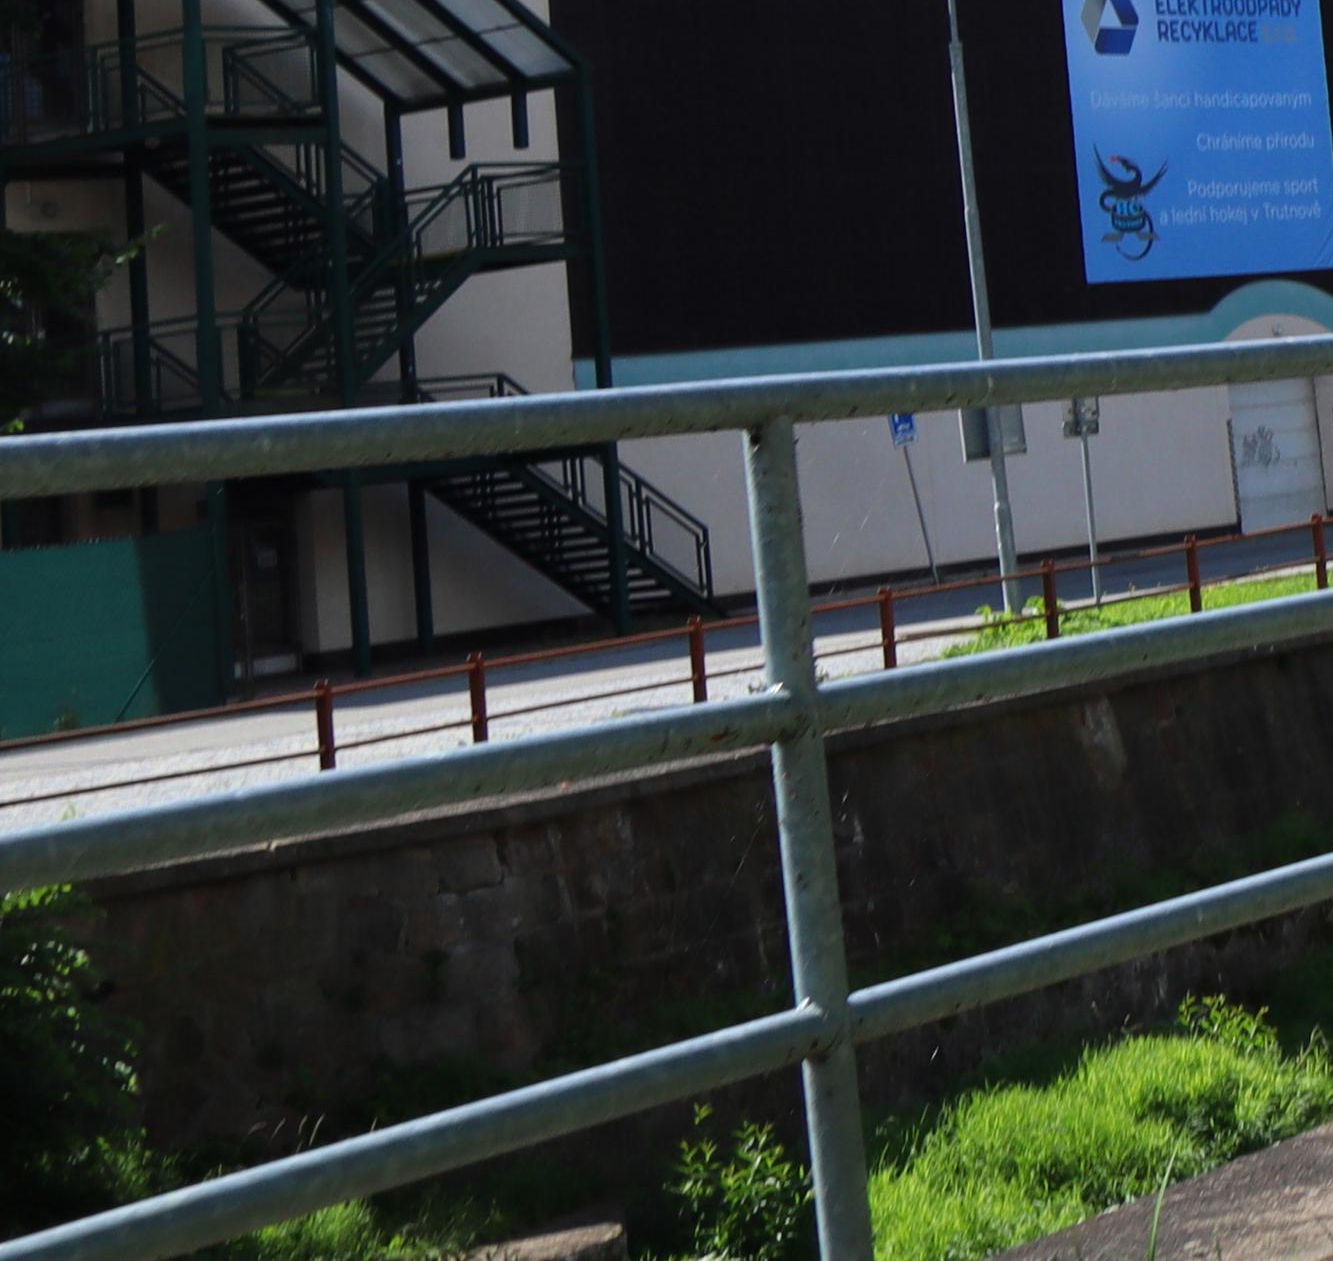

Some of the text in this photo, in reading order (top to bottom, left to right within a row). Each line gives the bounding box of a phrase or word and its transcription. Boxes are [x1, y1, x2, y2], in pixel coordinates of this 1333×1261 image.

[1157, 20, 1258, 42] RECYKLACE
[1194, 89, 1312, 109] handicapovaným
[1196, 132, 1262, 151] Chráníme
[1187, 178, 1319, 199] Podporujeme sport
[1159, 212, 1168, 225] a
[1171, 207, 1207, 224] lední
[1209, 203, 1247, 225] hokej
[1251, 209, 1259, 221] v
[1261, 200, 1321, 220] Trutnově
